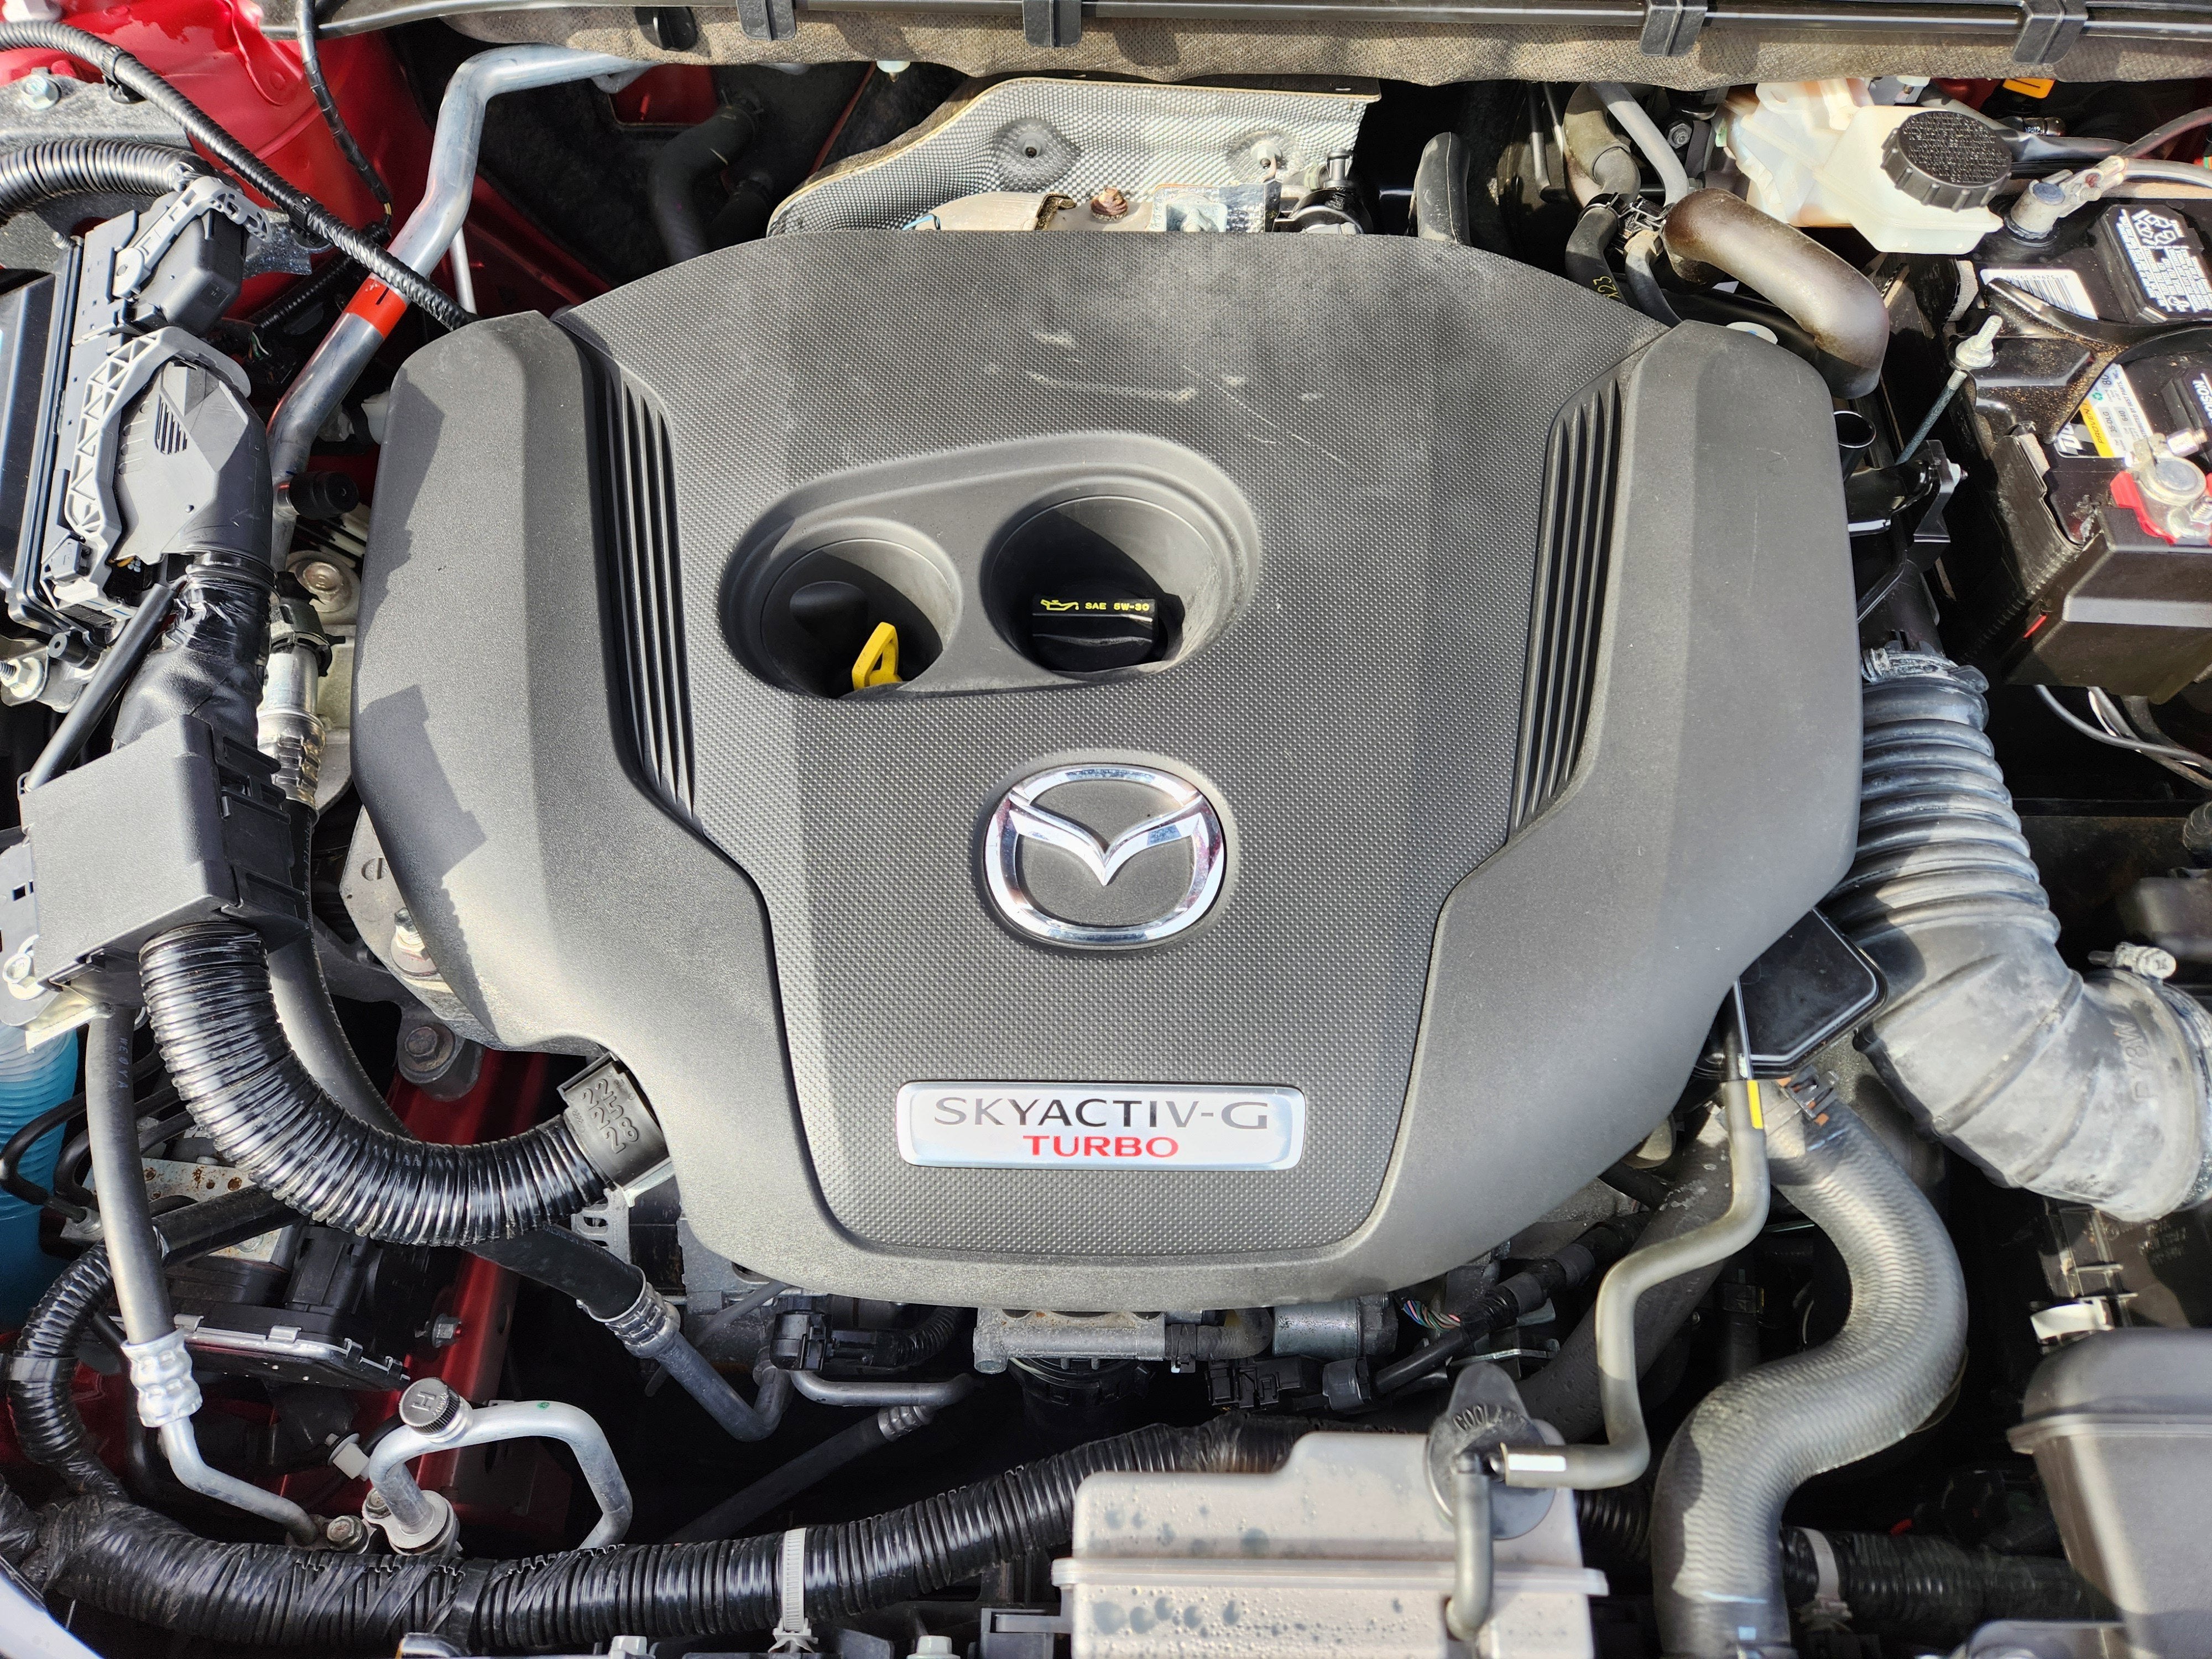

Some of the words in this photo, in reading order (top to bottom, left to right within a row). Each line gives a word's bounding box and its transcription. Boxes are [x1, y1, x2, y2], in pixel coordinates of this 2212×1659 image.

[2103, 411, 2117, 433] 35-DLG
[2119, 410, 2128, 421] 640
[2132, 414, 2148, 437] STRIBUTED
[1084, 602, 1107, 610] SAE
[1113, 602, 1150, 611] 5W-30
[579, 1078, 609, 1109] 22
[593, 1097, 624, 1130] 25
[934, 1097, 1268, 1129] SKYACTIV-G
[605, 1119, 639, 1154] 28
[1022, 1135, 1179, 1157] TURBO
